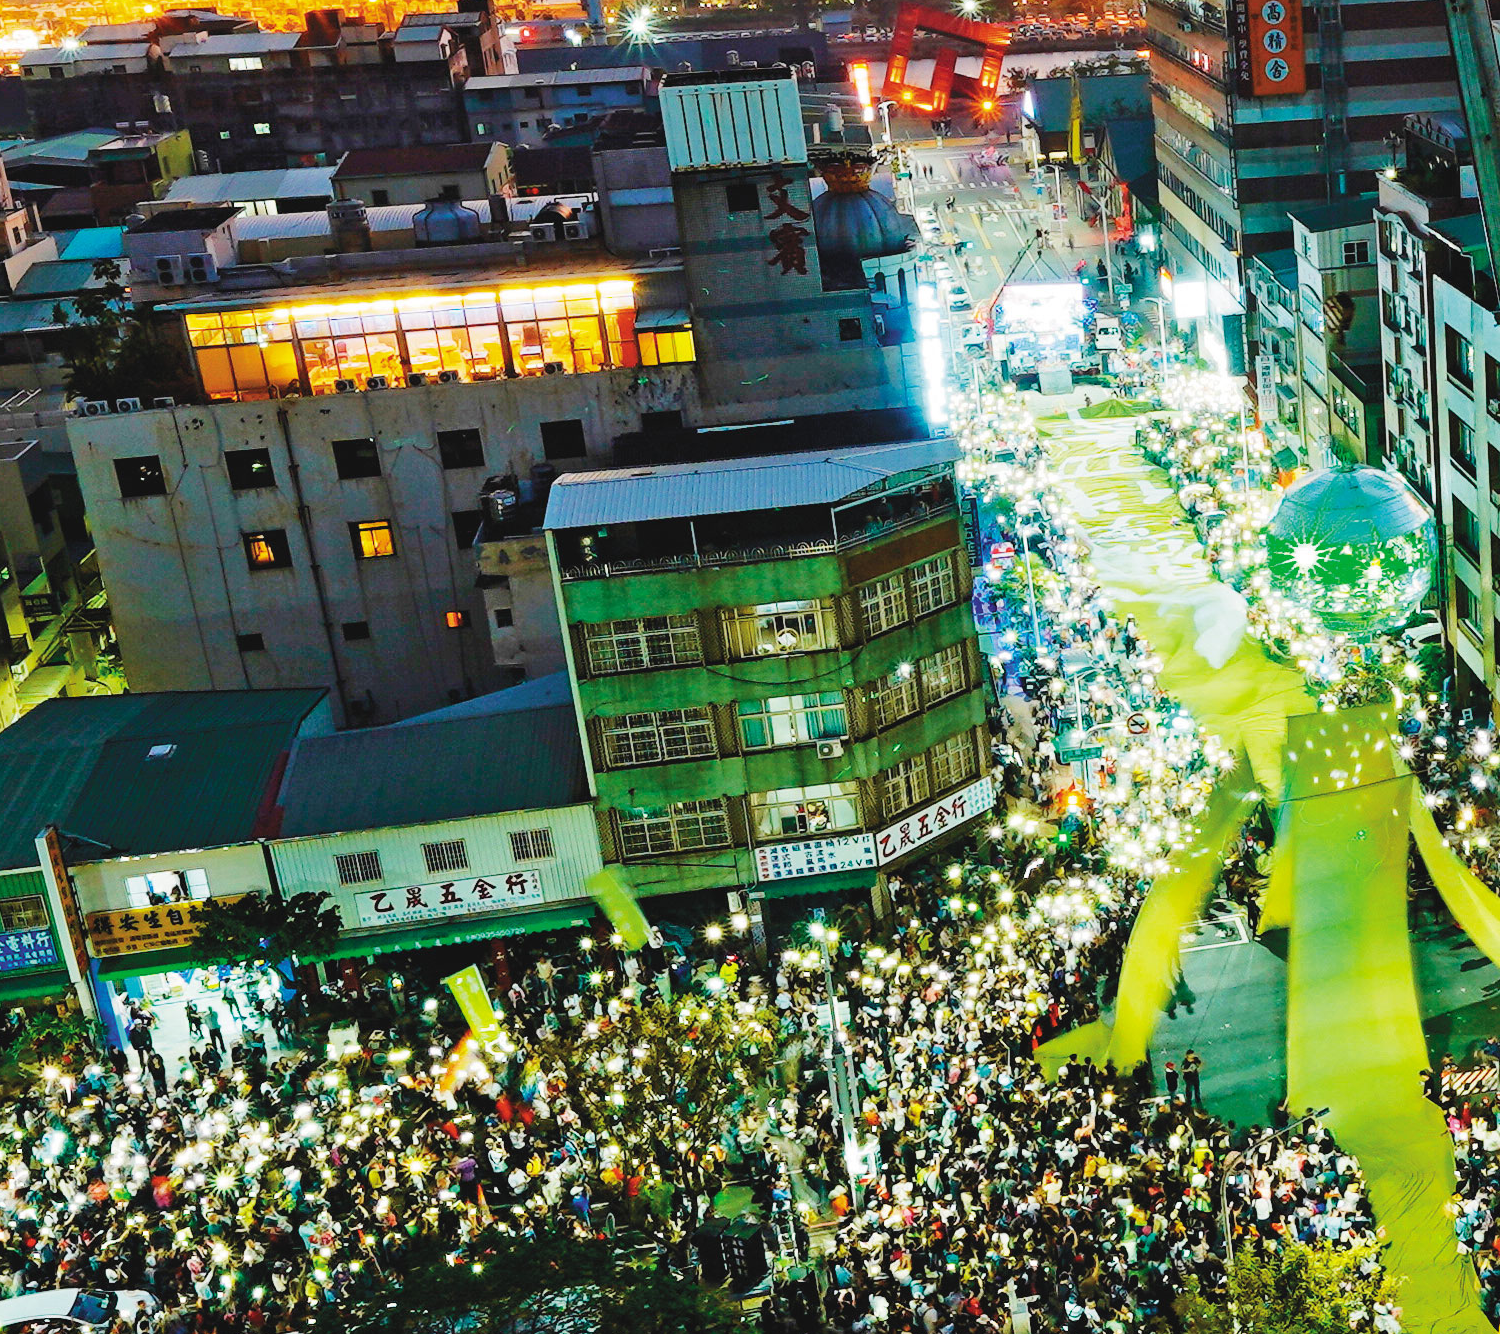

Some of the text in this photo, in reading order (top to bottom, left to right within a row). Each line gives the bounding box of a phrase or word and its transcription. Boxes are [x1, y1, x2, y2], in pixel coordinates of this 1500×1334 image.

[879, 794, 967, 858] 乙晟五金行
[369, 872, 528, 914] 乙晟五金行
